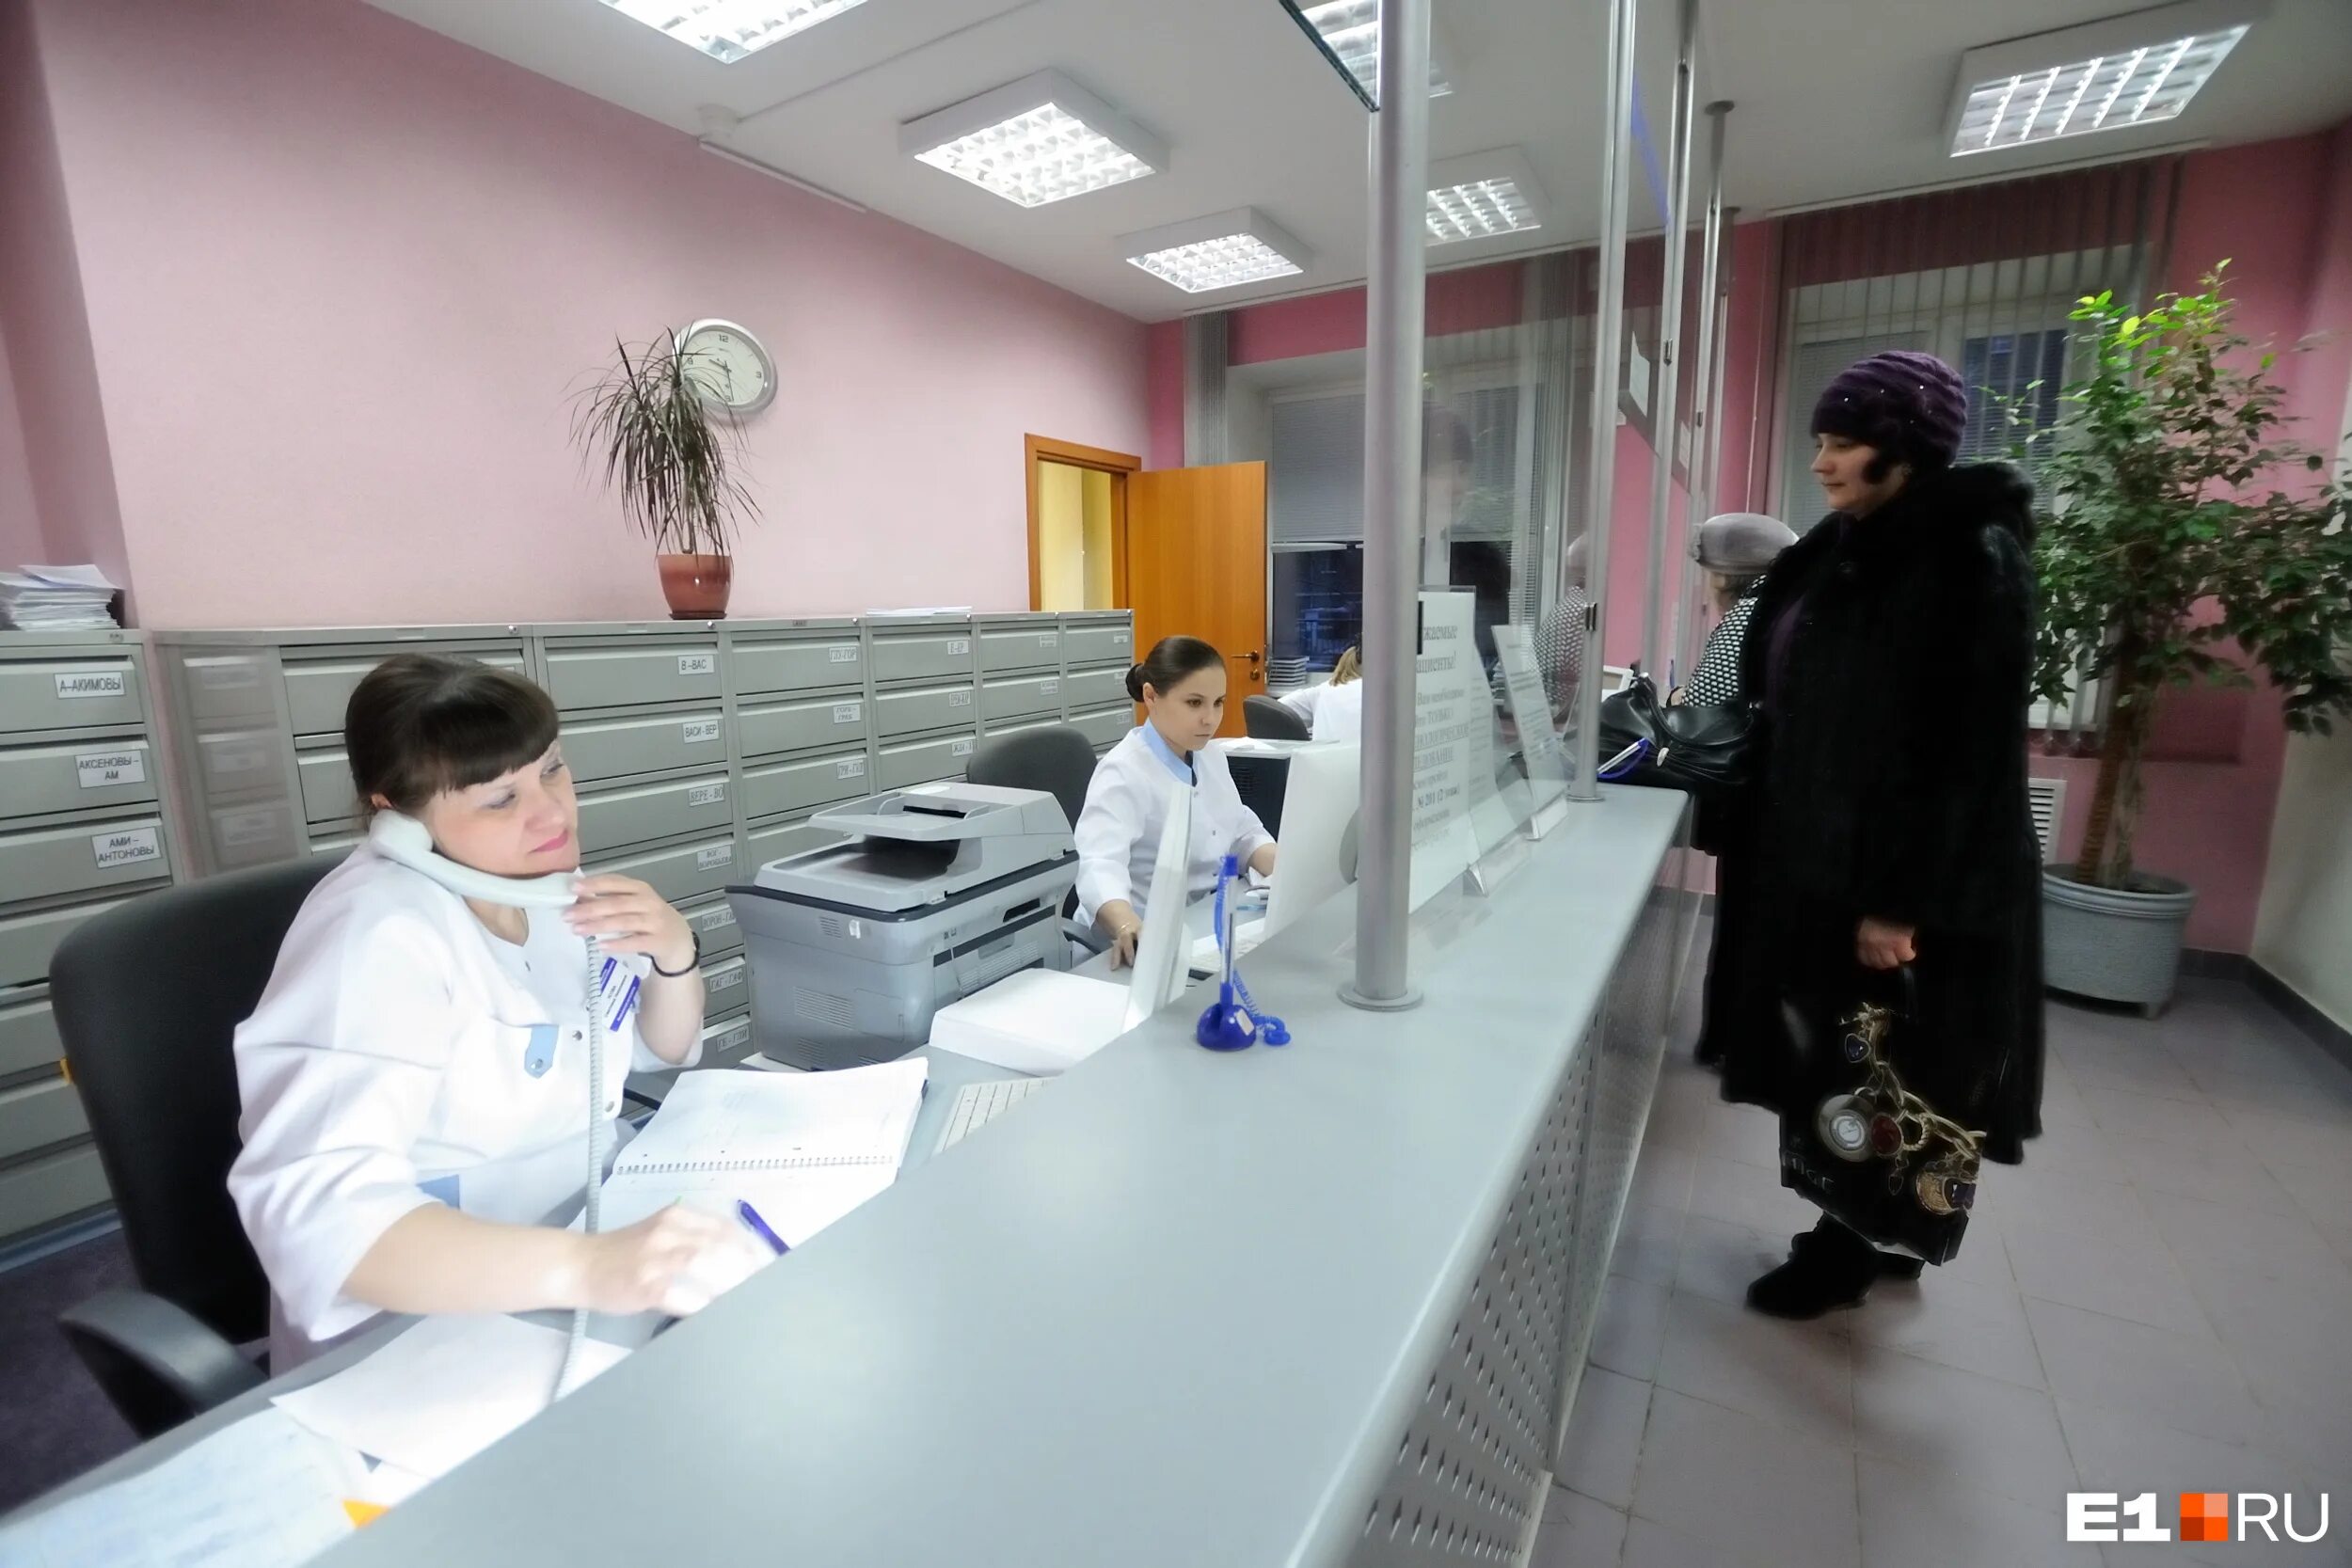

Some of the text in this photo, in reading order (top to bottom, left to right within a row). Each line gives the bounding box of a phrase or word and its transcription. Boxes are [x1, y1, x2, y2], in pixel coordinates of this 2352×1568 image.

[718, 334, 729, 343] 12
[78, 756, 132, 770] АКСЕНОВЫ
[104, 770, 119, 781] АМ
[108, 835, 132, 848] АМИ
[98, 846, 155, 864] АНТОНОВЫ
